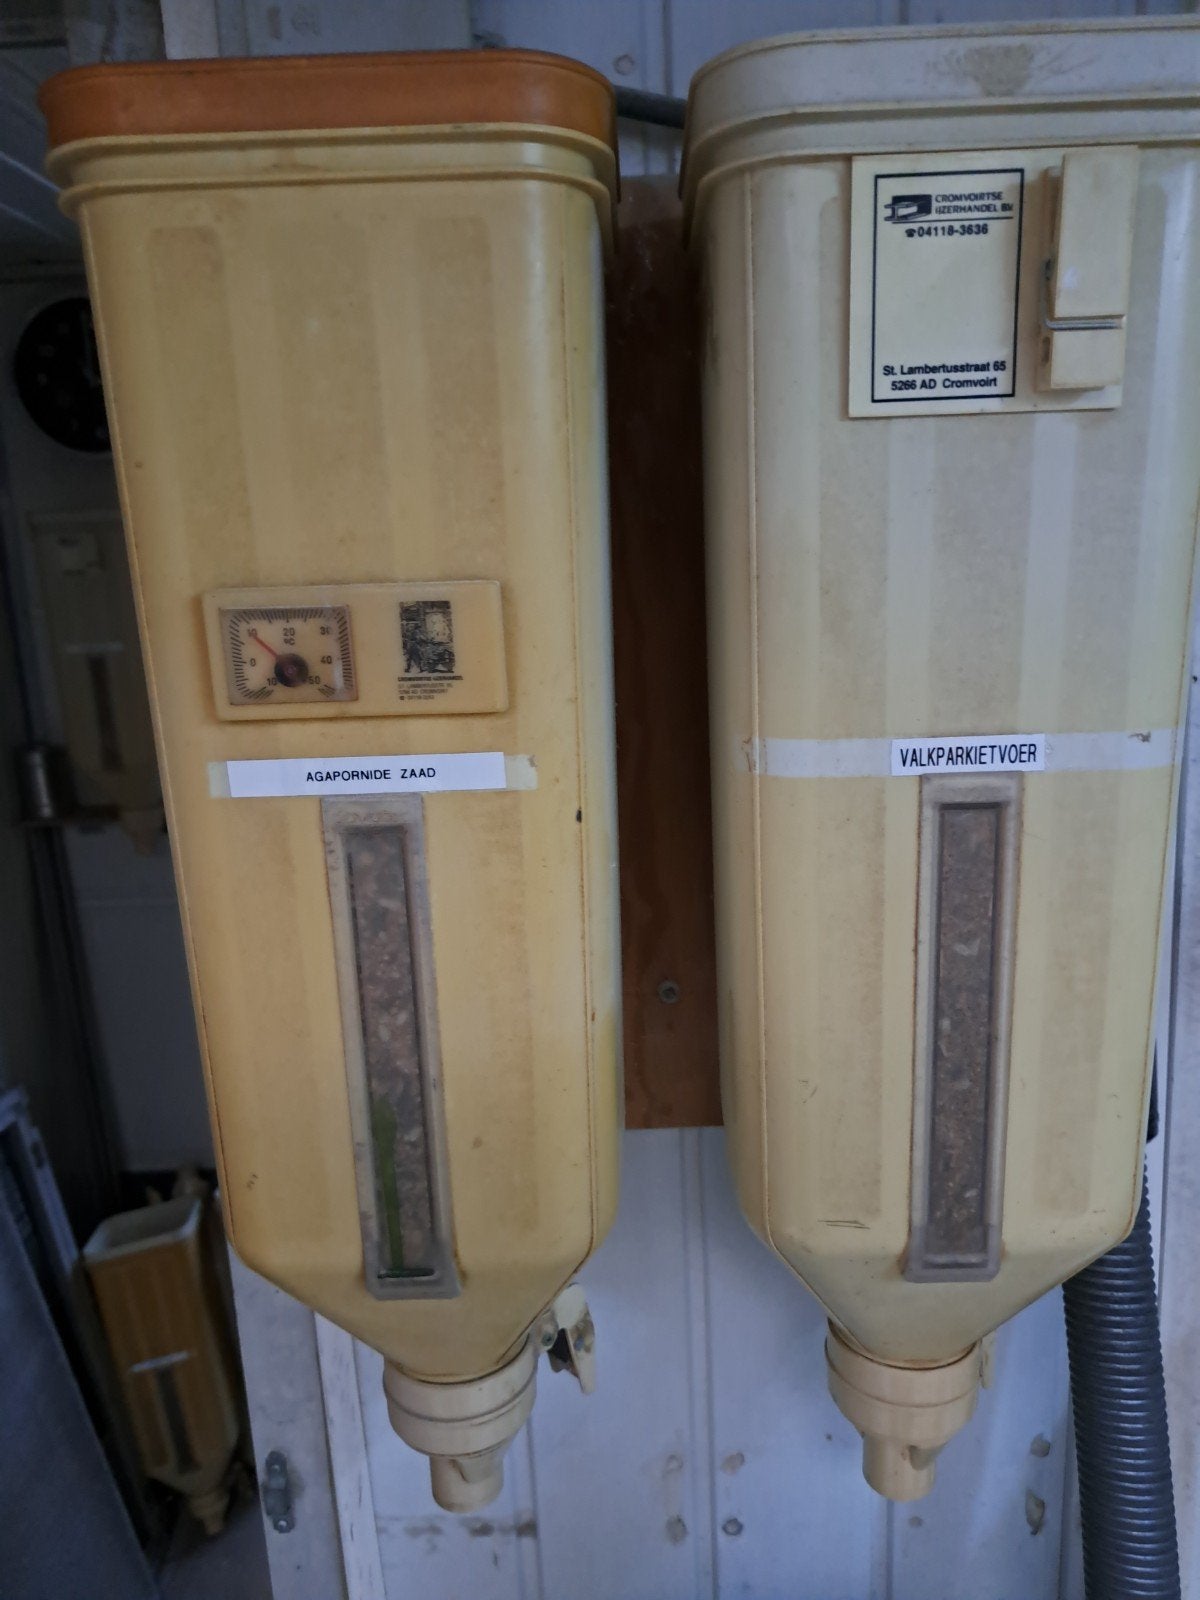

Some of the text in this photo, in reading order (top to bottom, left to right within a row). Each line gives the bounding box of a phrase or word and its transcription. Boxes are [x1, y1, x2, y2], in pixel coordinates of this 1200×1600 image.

[935, 191, 1003, 203] CROMVOIRTSE
[882, 360, 1006, 376] St. Lambertusstraat 65
[891, 376, 997, 391] 5266 AD Cromvoirt
[283, 627, 296, 637] 20
[249, 658, 256, 667] 0
[321, 655, 332, 665] 40
[900, 743, 1037, 767] VALKPARKIETVOER
[306, 767, 436, 782] AGAPORNIDE ZAAD
